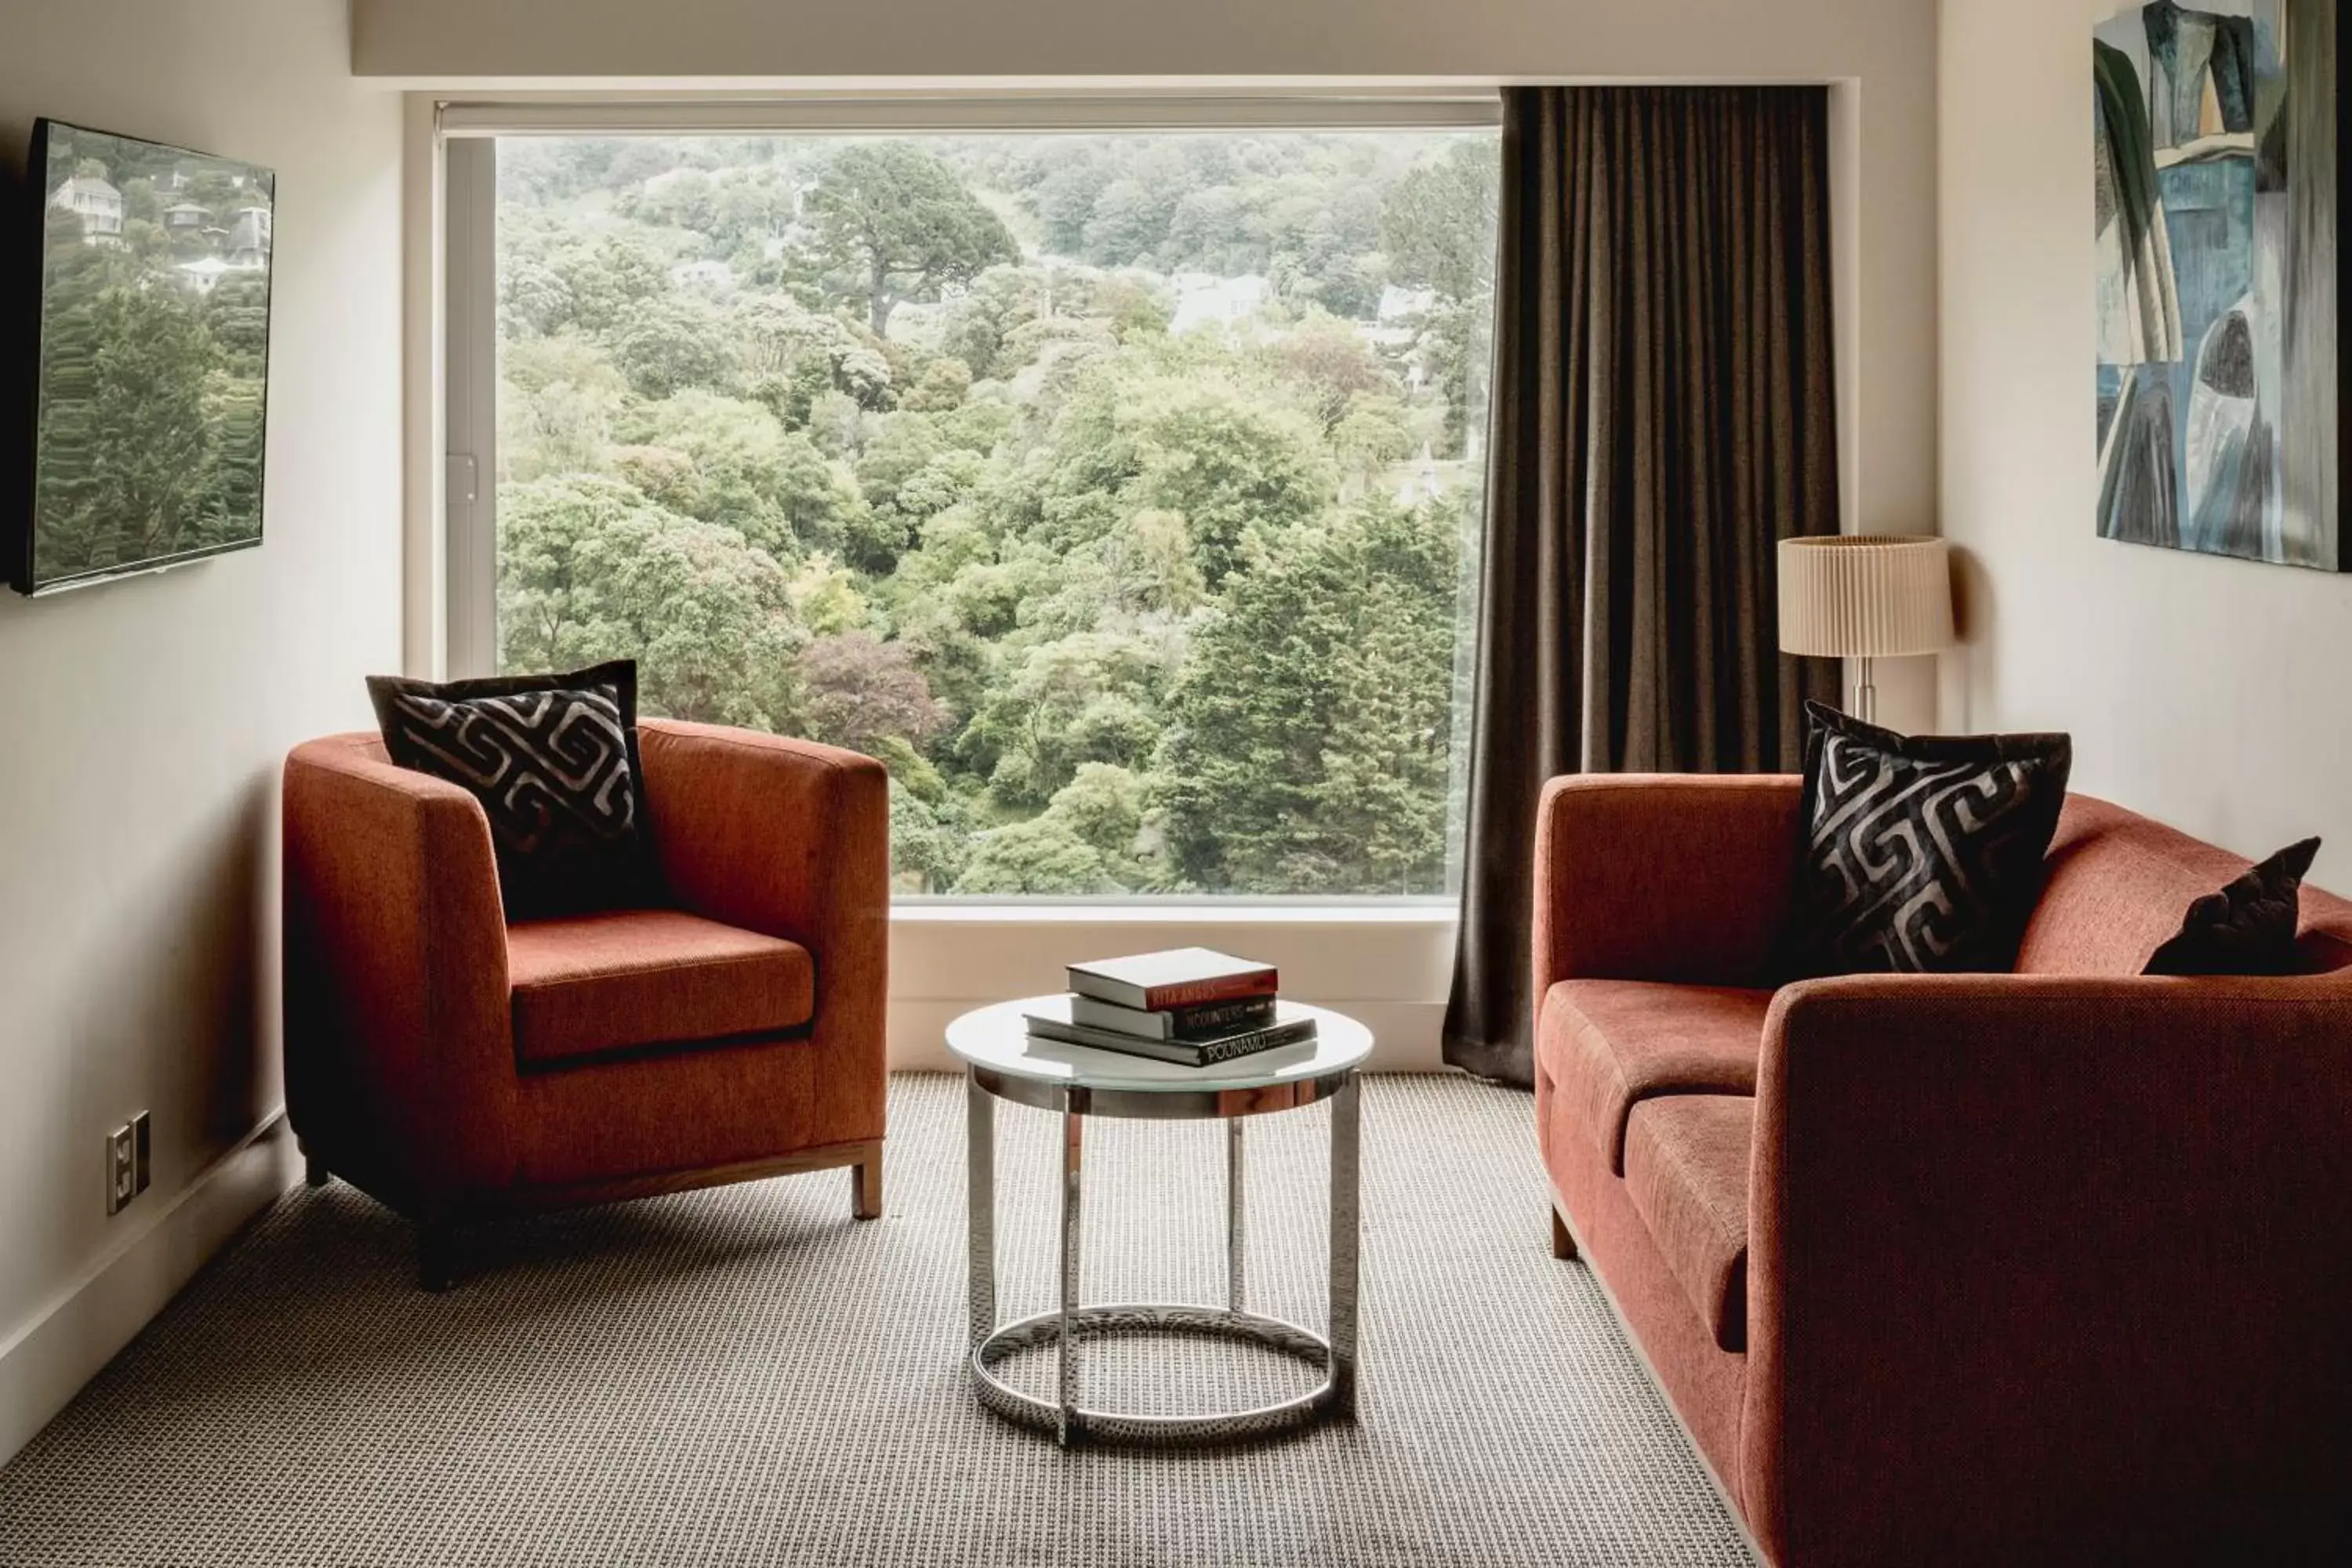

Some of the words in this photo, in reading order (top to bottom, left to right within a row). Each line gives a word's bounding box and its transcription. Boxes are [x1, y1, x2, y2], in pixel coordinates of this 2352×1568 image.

[1152, 989, 1177, 1007] RITA
[1179, 981, 1216, 1004] ANGUS
[1207, 1033, 1266, 1062] POUNAMU
